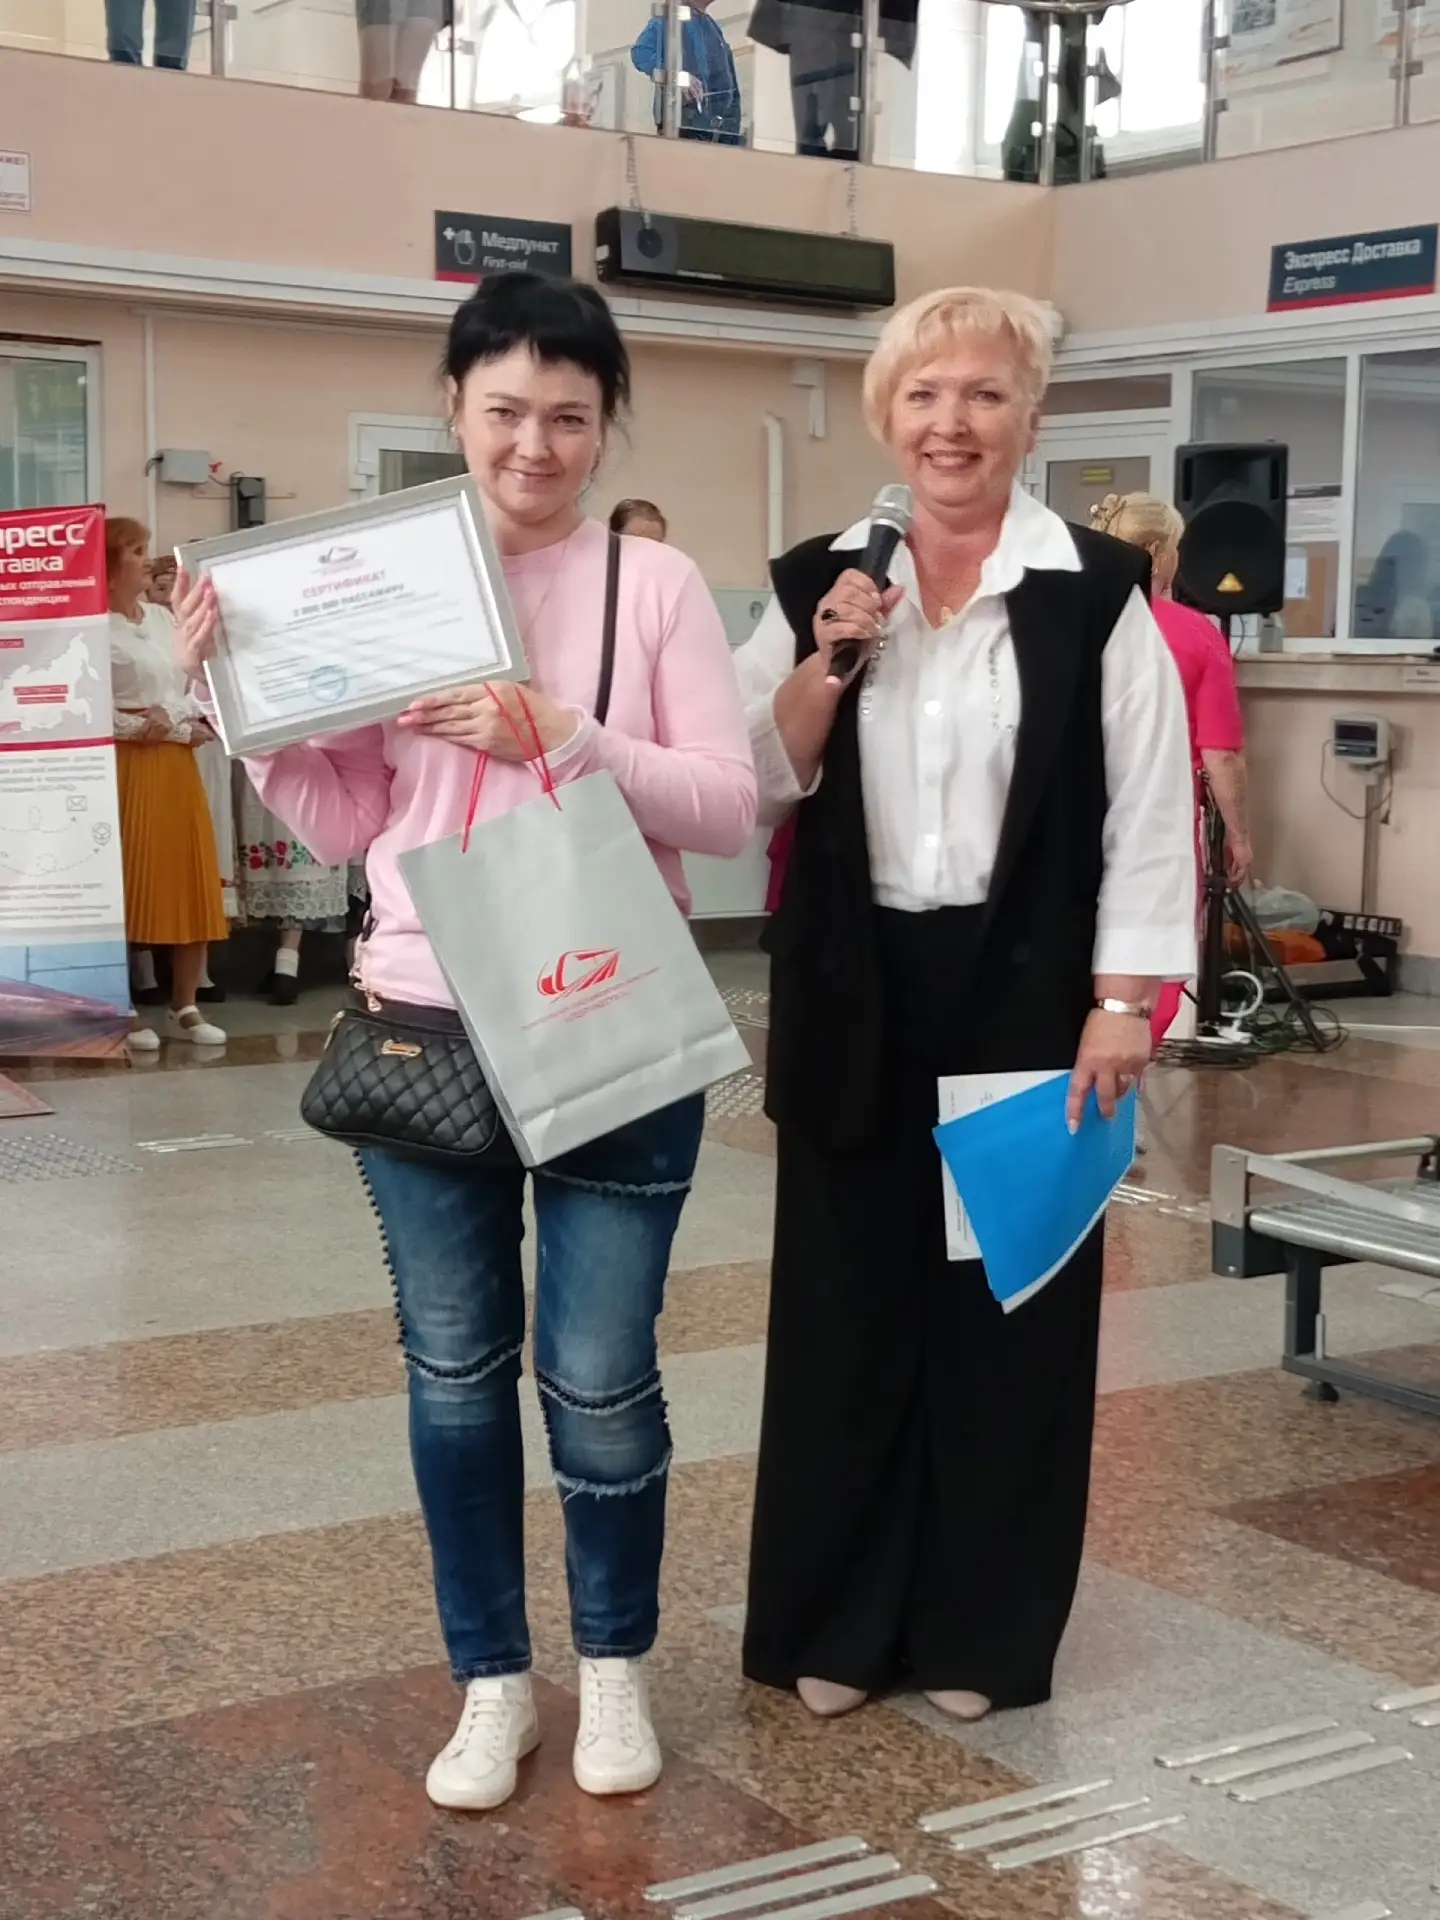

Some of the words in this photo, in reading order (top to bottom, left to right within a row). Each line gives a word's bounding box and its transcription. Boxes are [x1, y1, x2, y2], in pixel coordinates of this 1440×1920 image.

[482, 231, 559, 255] Медпункт
[1284, 248, 1350, 271] Экспресс
[1352, 239, 1422, 265] Доставка
[482, 256, 528, 270] First-aid
[1282, 276, 1337, 295] Express
[0, 523, 85, 555] ресс
[302, 570, 386, 599] СЕРТИФИКАТ
